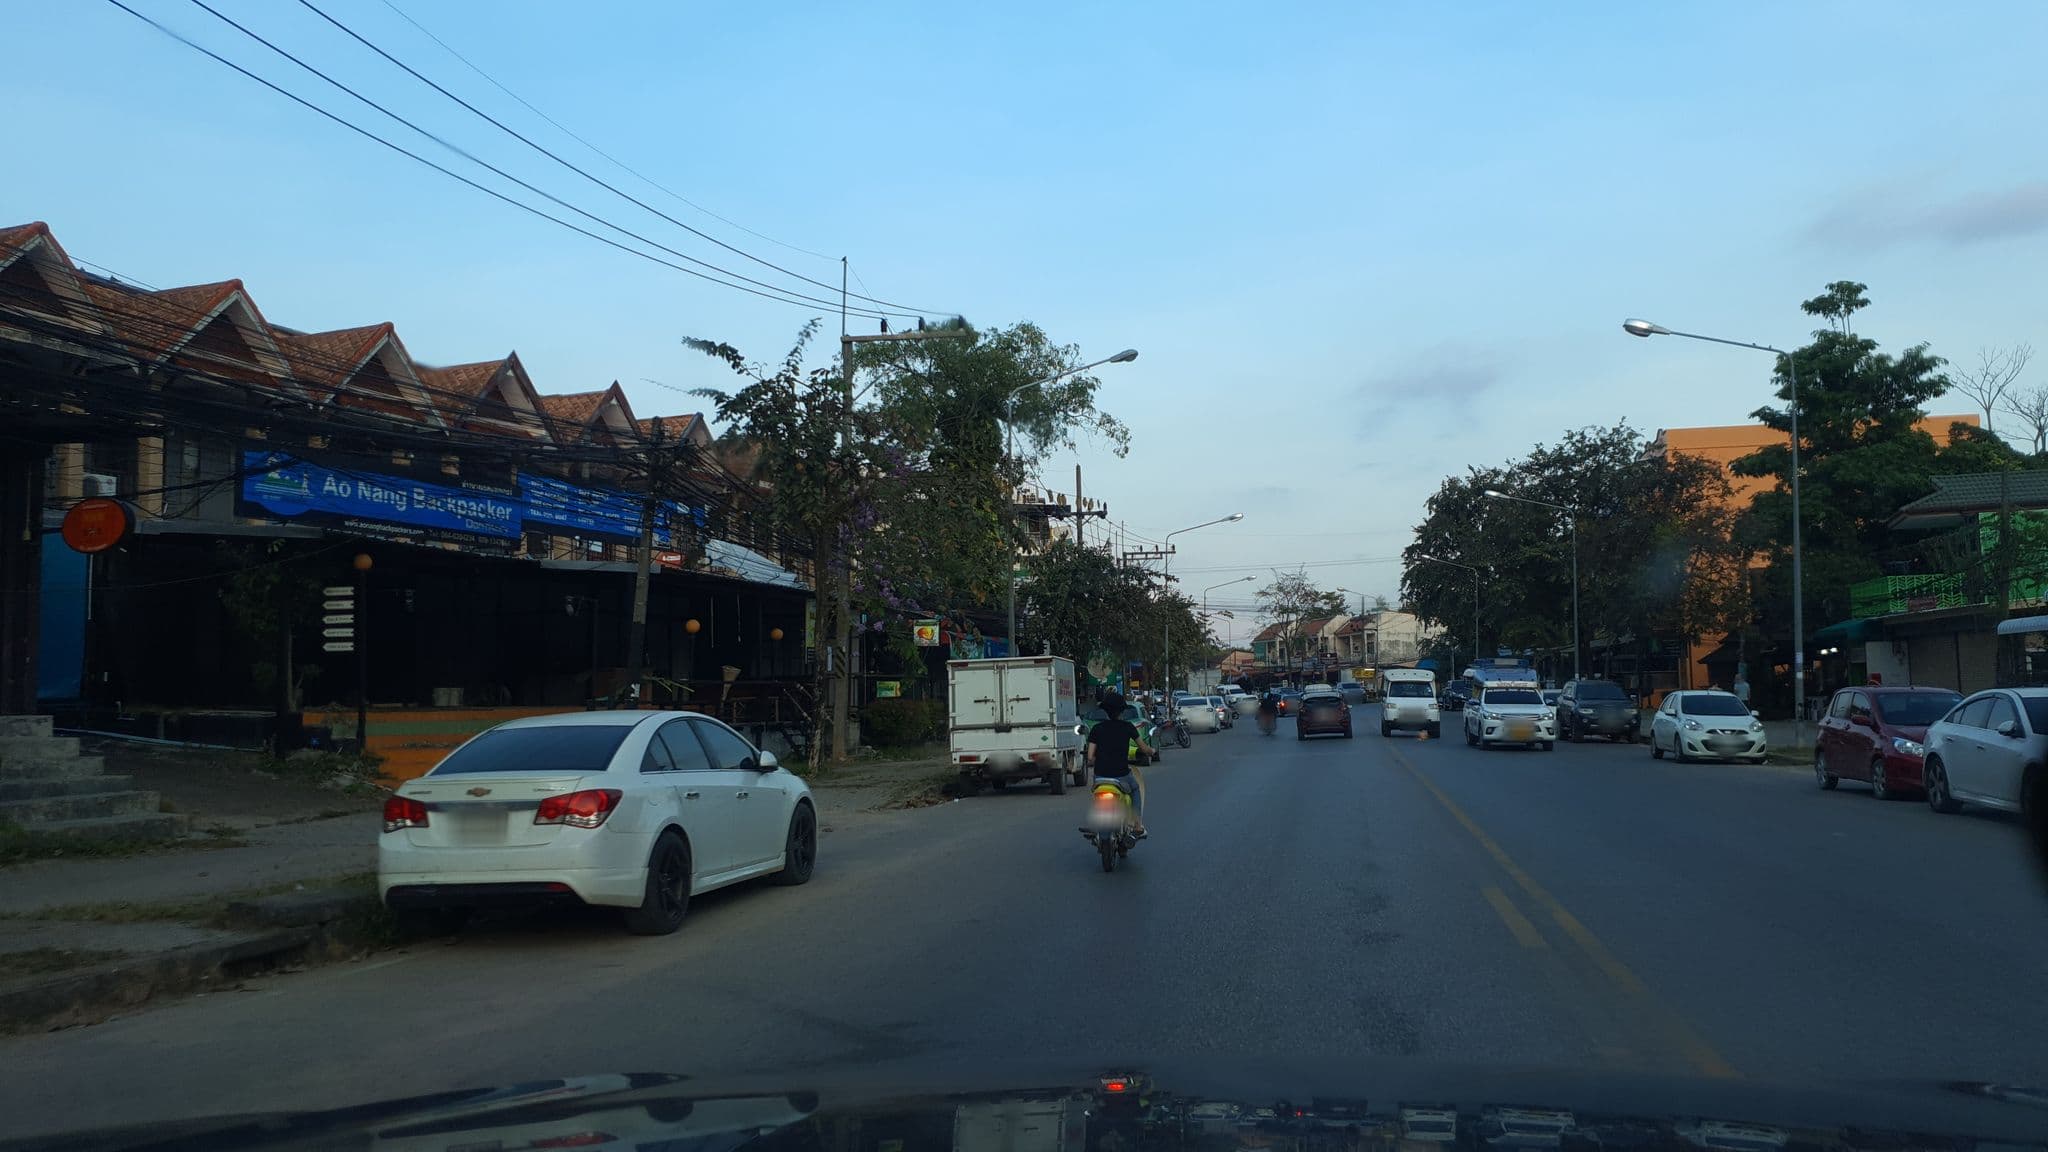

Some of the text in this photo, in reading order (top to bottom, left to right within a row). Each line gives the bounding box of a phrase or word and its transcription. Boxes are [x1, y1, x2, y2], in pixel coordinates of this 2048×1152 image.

[322, 475, 352, 498] Ao
[357, 481, 408, 512] Nang
[413, 488, 513, 521] Backpacker
